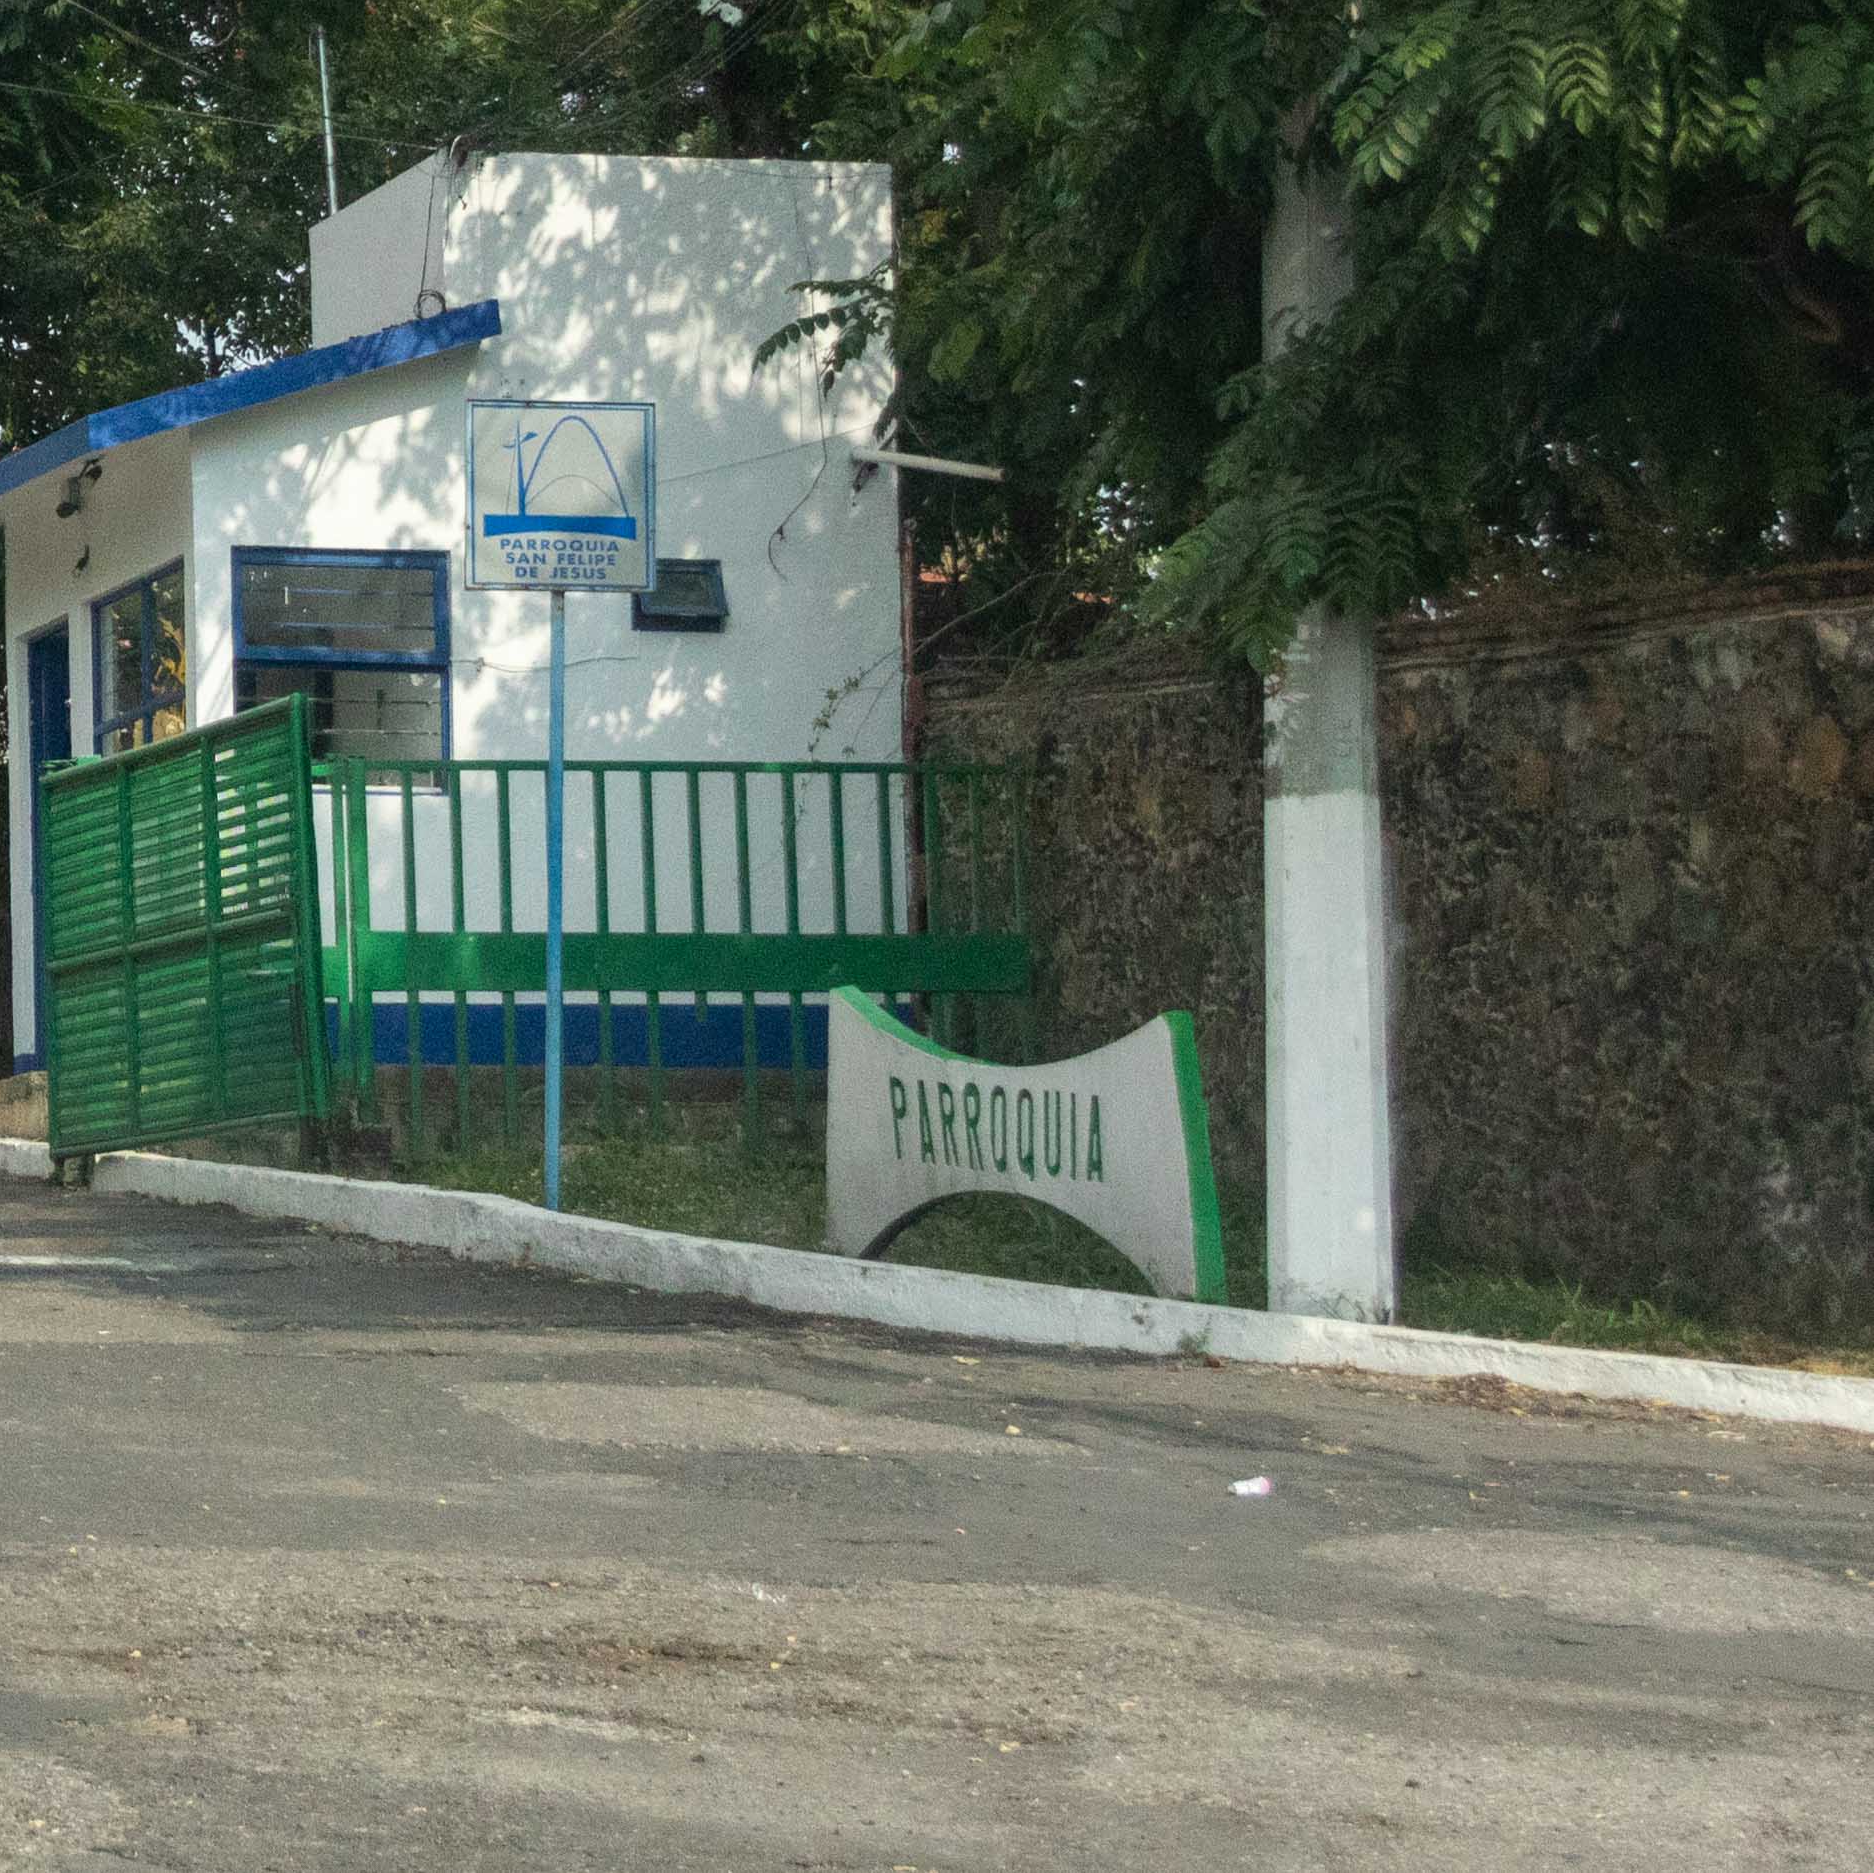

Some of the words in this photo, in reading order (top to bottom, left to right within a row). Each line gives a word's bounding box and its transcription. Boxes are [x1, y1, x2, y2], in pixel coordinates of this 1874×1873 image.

[500, 538, 620, 552] PARROQUIA
[506, 552, 546, 565] SAN
[557, 553, 617, 567] FELIPE
[515, 566, 539, 578] DE
[549, 567, 607, 580] JESUS
[889, 1075, 1104, 1183] PARROQUIA
